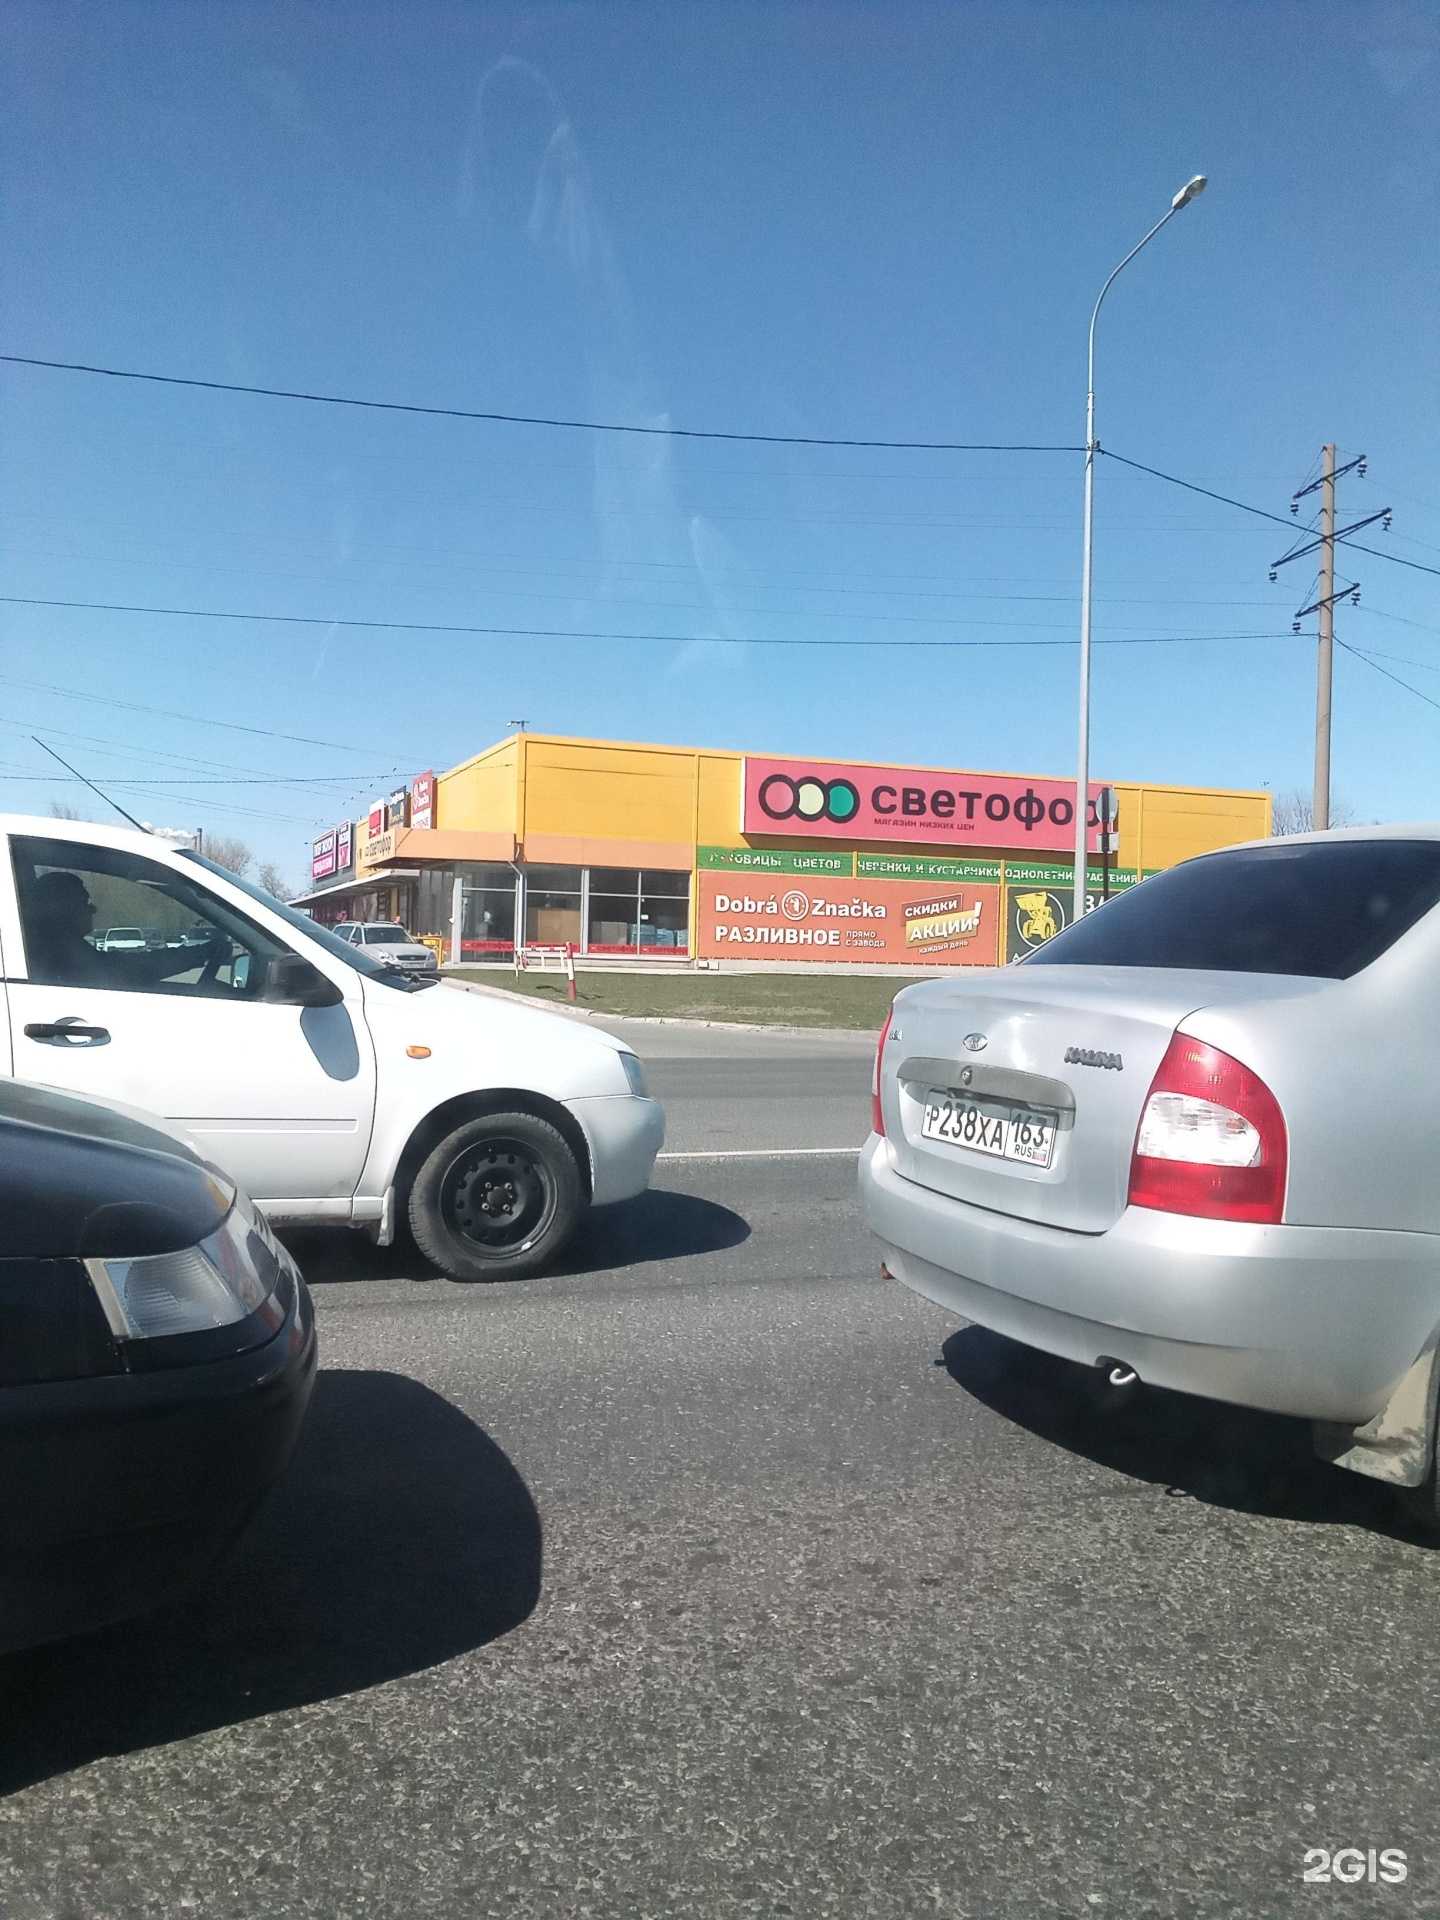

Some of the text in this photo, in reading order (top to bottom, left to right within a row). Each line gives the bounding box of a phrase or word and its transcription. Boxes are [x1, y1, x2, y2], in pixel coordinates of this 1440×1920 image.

[715, 894, 887, 918] Dobrá Značka
[715, 925, 841, 946] РАЗЛИВНОЕ
[846, 930, 877, 940] прямо
[1011, 1113, 1048, 1147] 163
[1014, 1144, 1033, 1158] RUS
